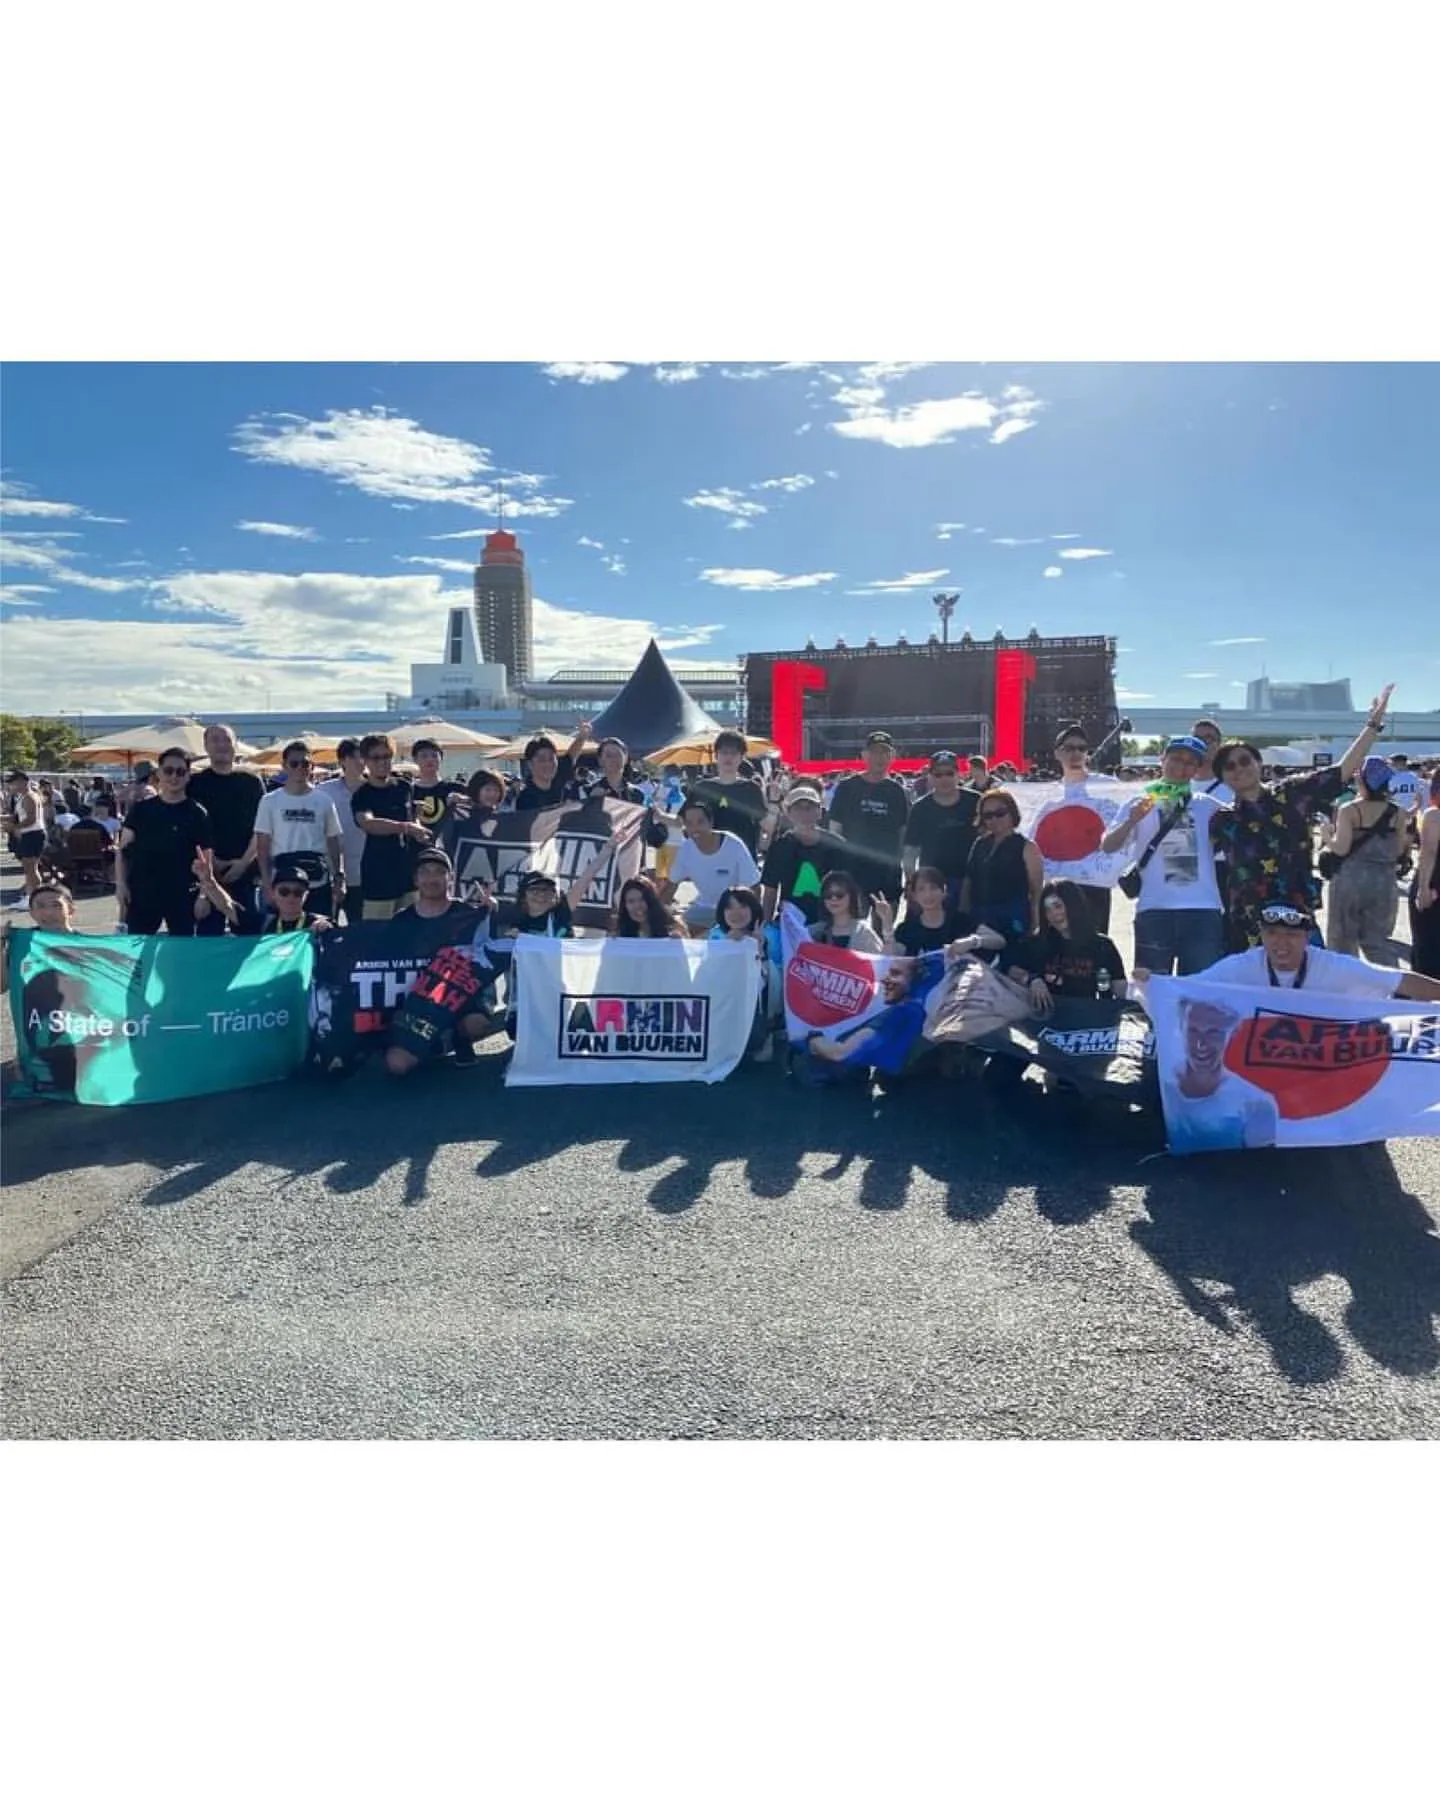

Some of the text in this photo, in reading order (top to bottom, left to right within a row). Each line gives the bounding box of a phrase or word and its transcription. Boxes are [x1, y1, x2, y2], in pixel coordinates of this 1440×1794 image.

[392, 959, 413, 968] VAN
[29, 1008, 289, 1037] A State of Trance
[567, 1000, 704, 1033] ARMIN
[568, 1033, 702, 1053] VAN BUUREN
[1259, 1040, 1325, 1061] VAN
